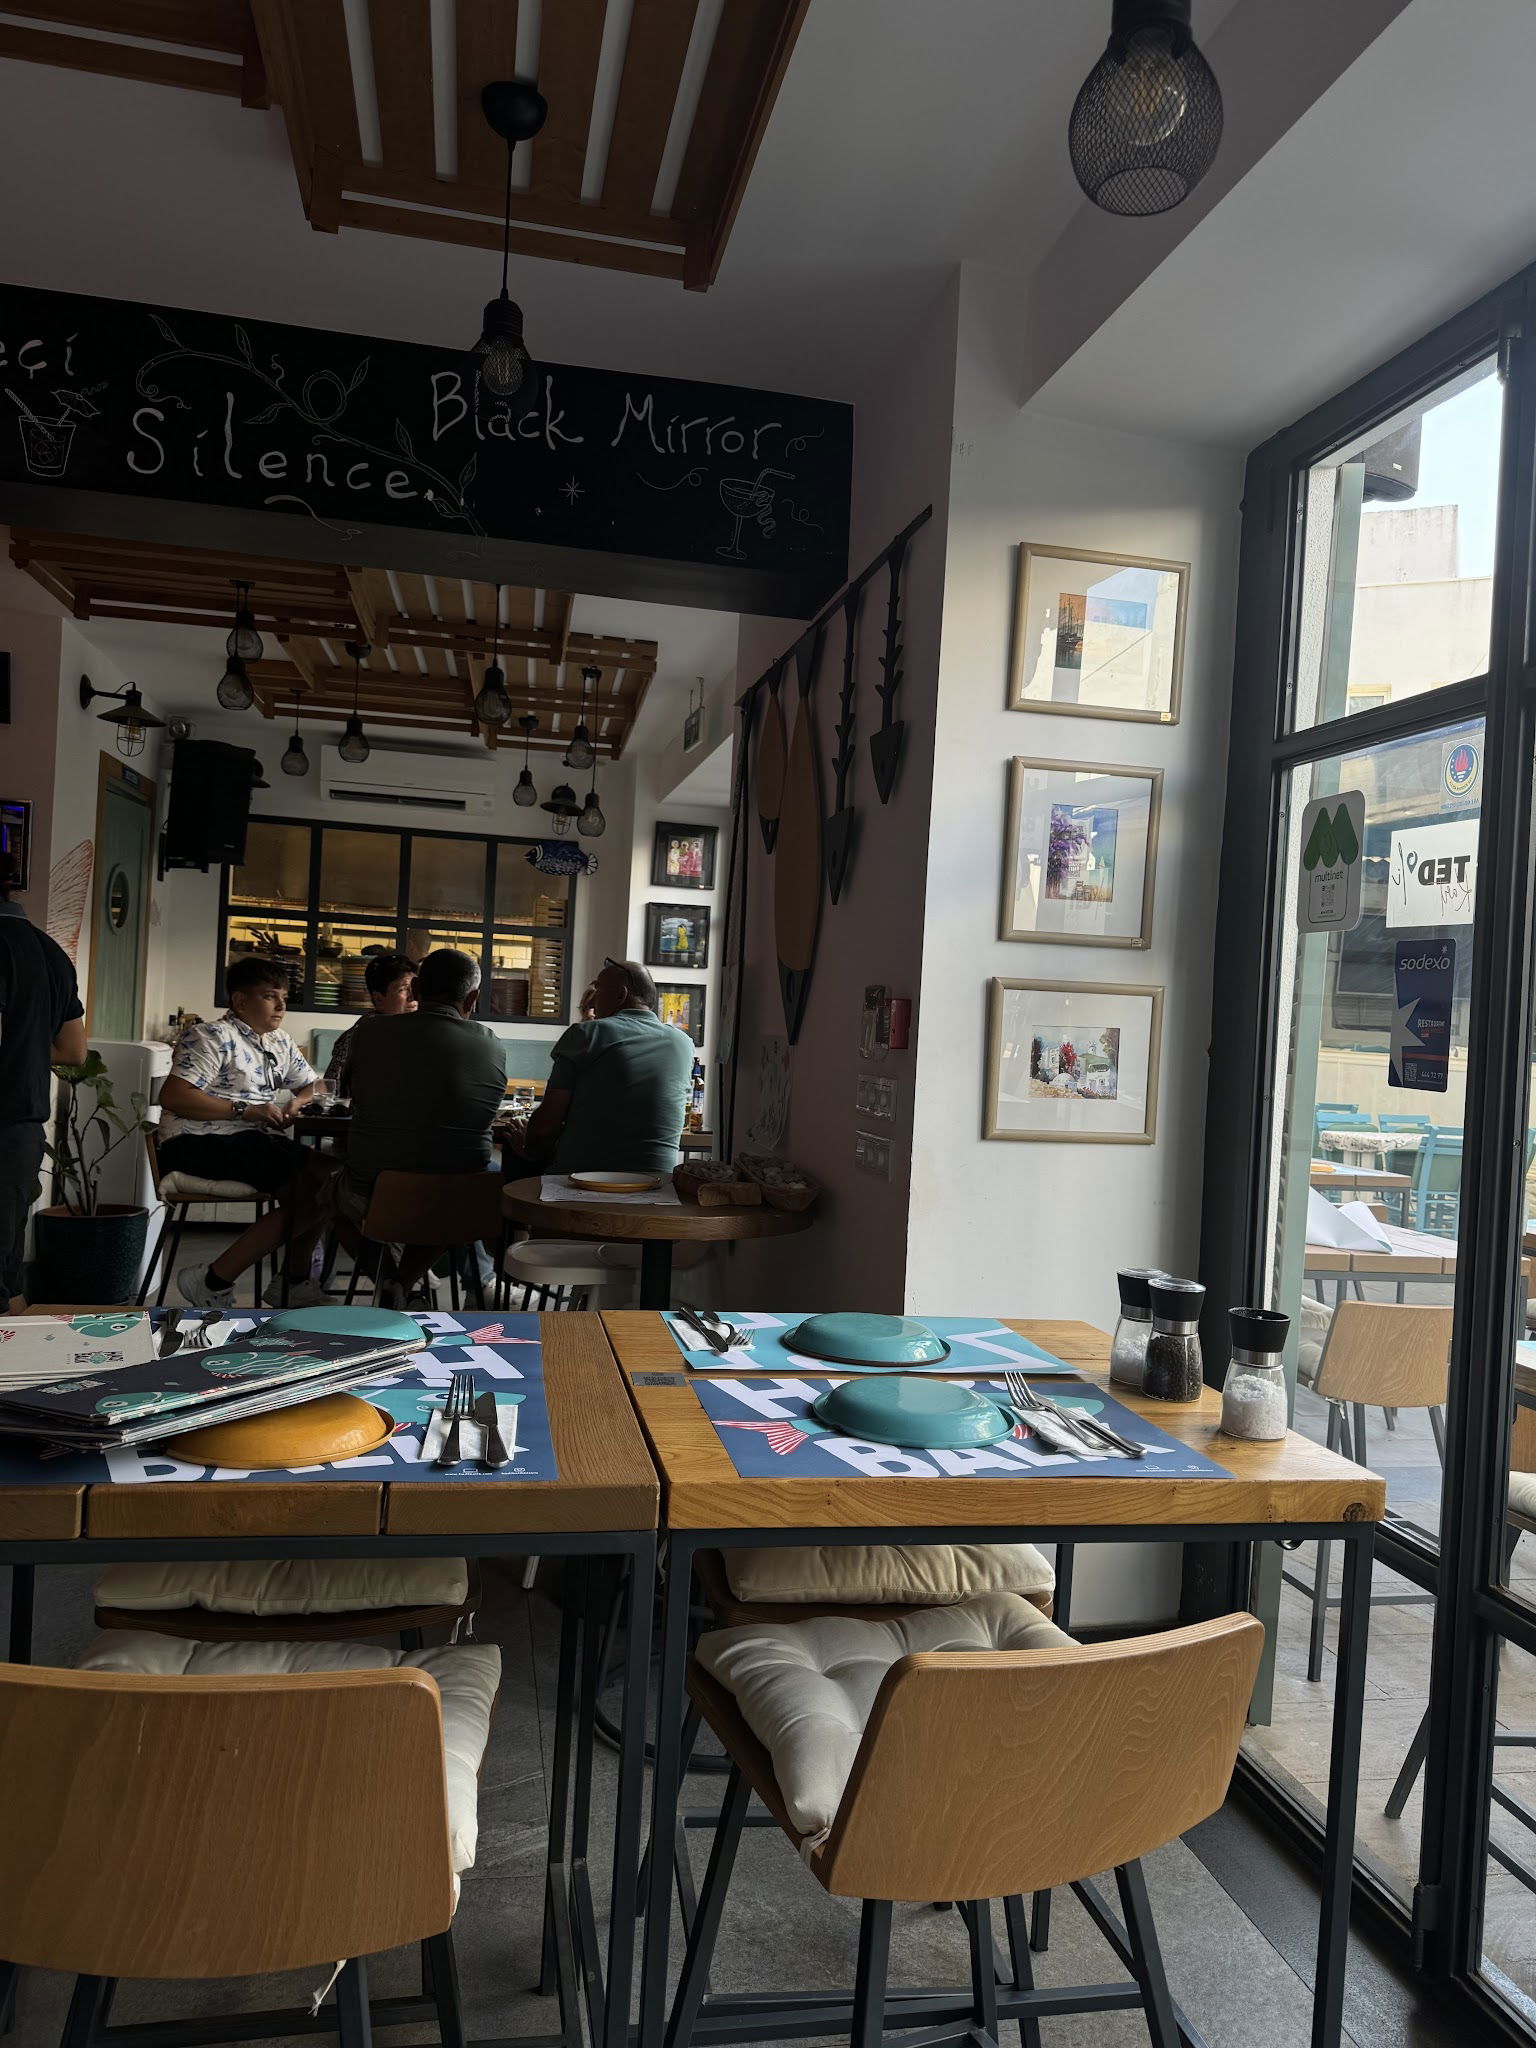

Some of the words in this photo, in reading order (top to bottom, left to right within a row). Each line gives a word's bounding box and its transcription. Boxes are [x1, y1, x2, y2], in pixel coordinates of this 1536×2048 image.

[430, 370, 584, 450] Black
[611, 392, 782, 459] Mirror
[1314, 870, 1344, 882] multinet
[1399, 952, 1451, 971] sodexo
